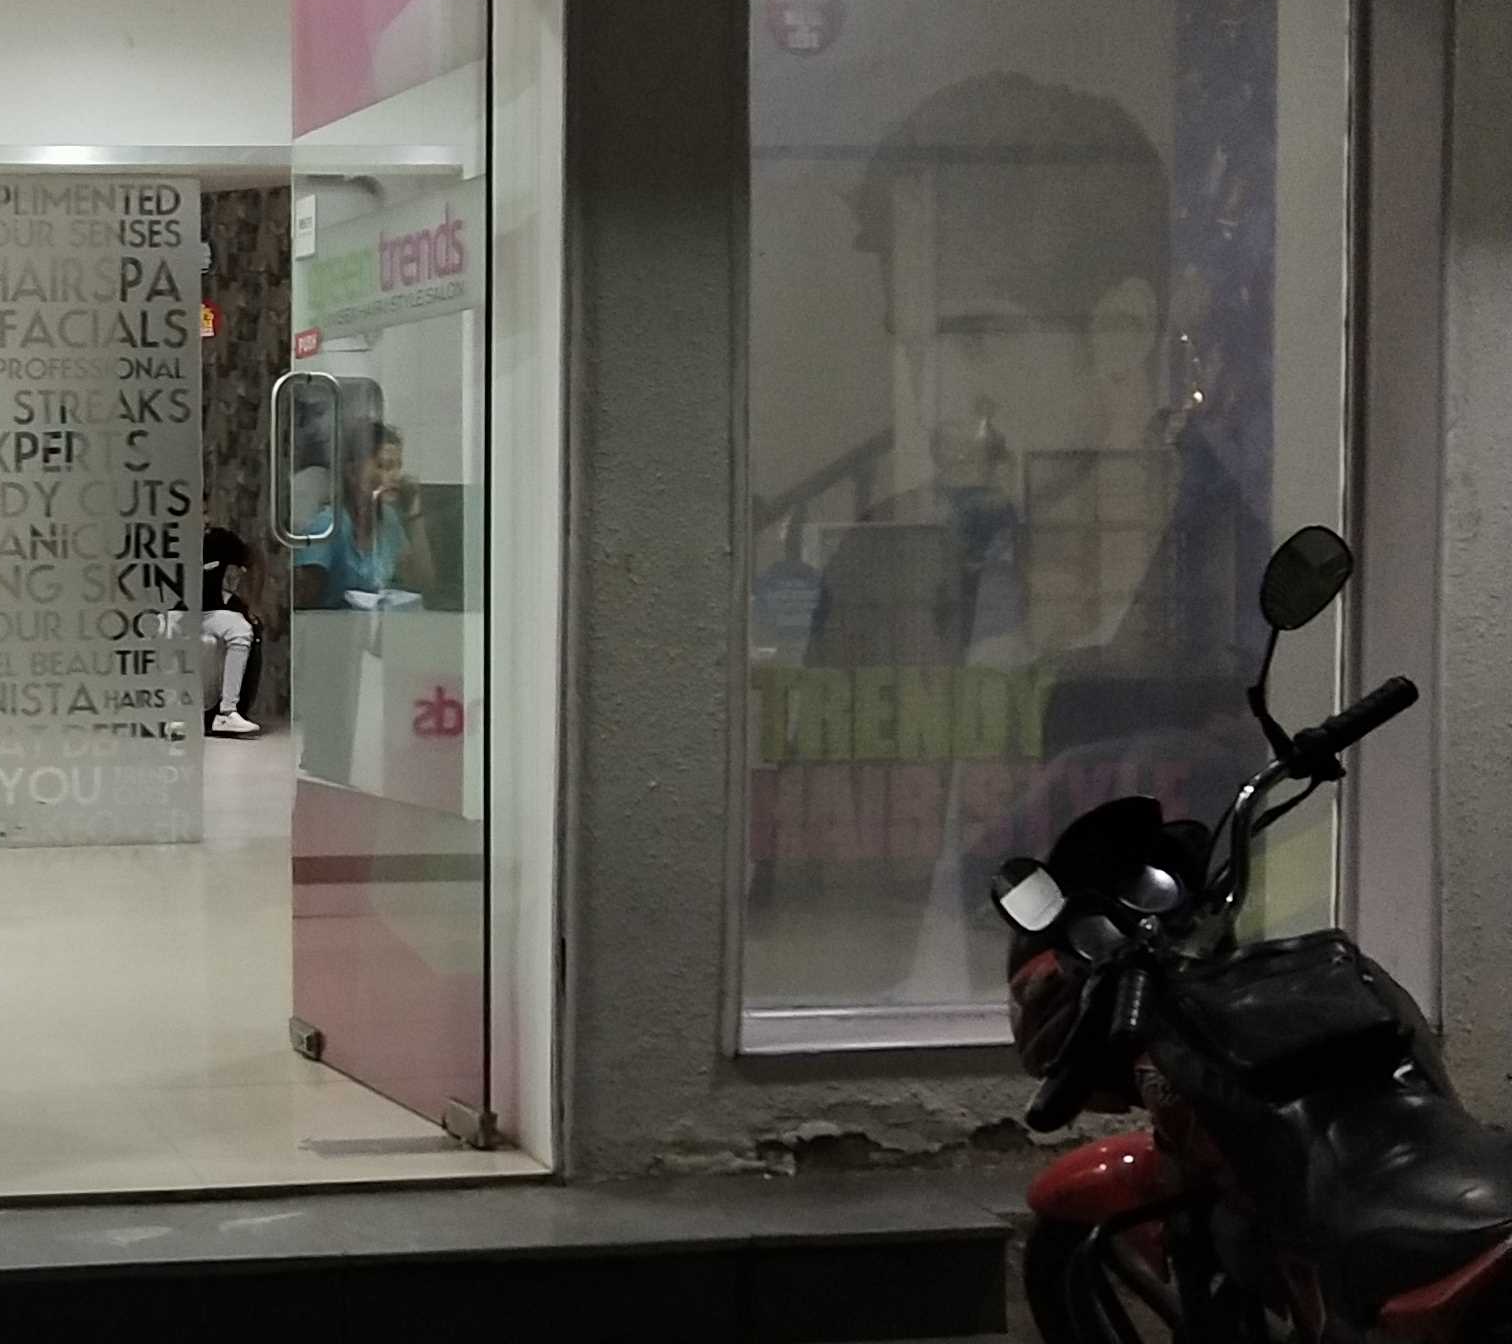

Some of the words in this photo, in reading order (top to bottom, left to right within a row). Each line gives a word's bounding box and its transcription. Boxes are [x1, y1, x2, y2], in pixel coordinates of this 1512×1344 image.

[69, 219, 183, 248] SENSES
[378, 202, 466, 292] trends
[13, 388, 192, 426] STREAKS
[77, 479, 193, 518] CUTS
[80, 562, 186, 605] SKIN
[77, 607, 185, 642] LOOK
[752, 664, 1058, 762] TRENDY
